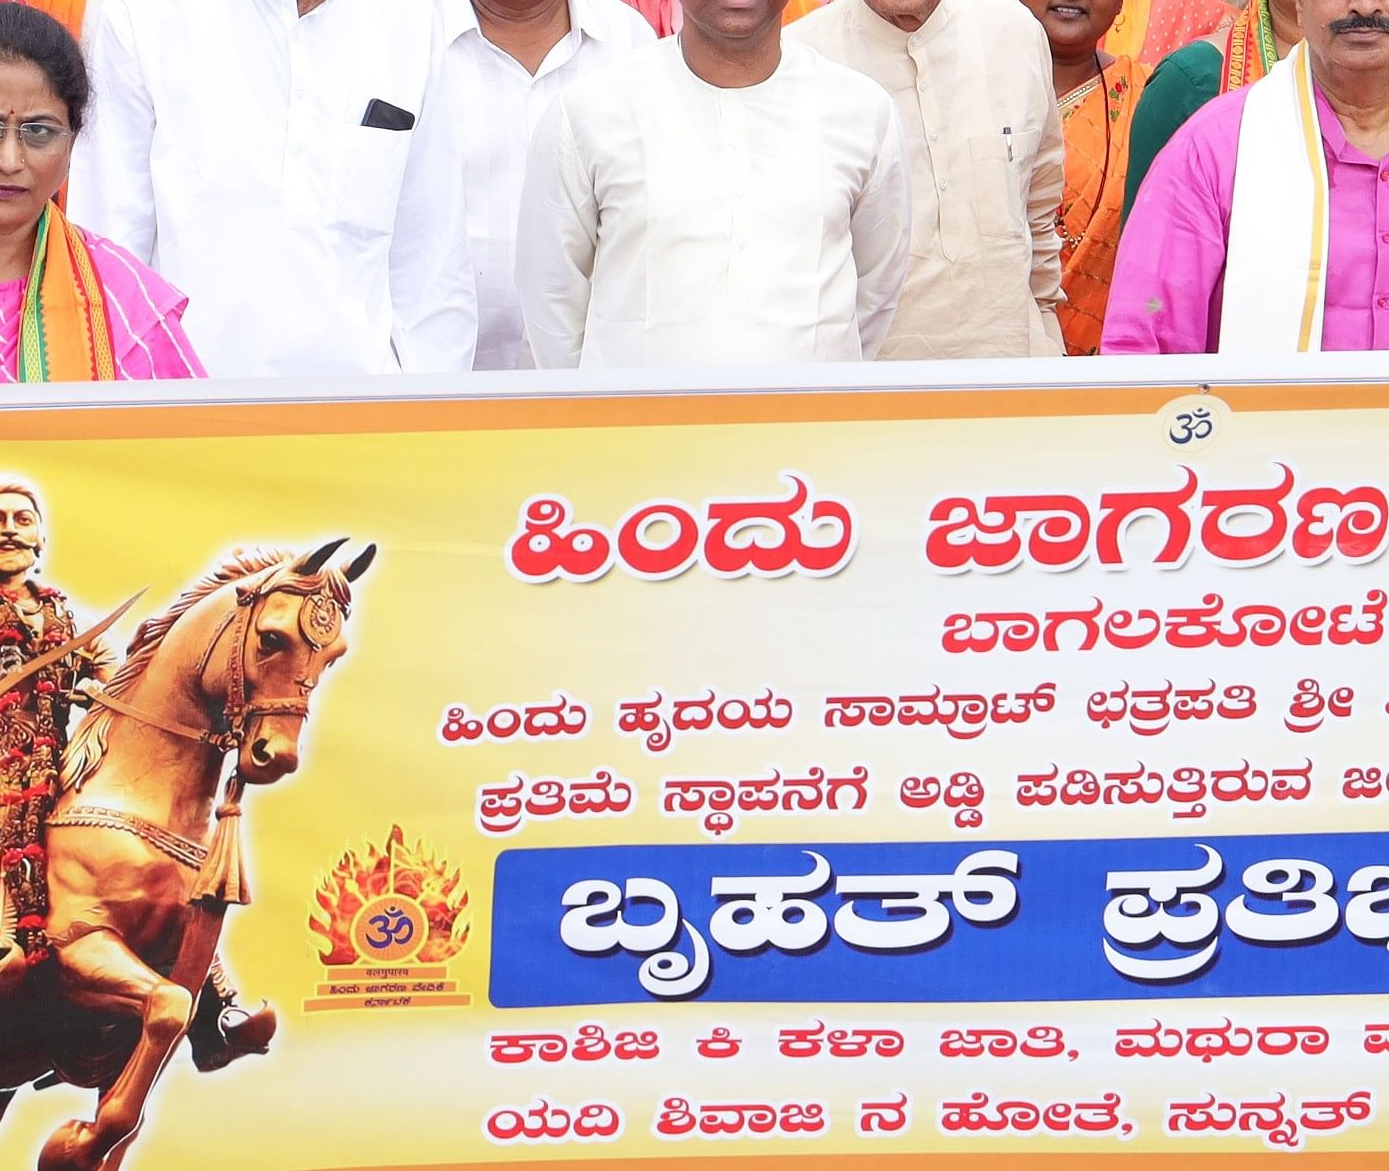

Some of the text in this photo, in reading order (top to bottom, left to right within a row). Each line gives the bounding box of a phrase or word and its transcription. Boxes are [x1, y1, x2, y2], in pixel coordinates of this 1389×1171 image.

[513, 474, 851, 575] ಹಿಂದು
[927, 463, 1388, 567] ಜಾಗರಣ
[943, 590, 1387, 654] ಬಾಗಲಕೋಟೆ
[443, 699, 584, 740] ಹಿಂದು
[620, 693, 791, 751] ಹೃದಯ
[826, 680, 1055, 739] ಸಾಮ್ರಾಟ್
[1088, 683, 1256, 735] ಛತ್ರಪತಿ
[1288, 678, 1353, 732] ಶ್ರೀ
[482, 769, 629, 831] ಪ್ರತಿಮೆ
[665, 764, 867, 833] ಸ್ಥಾಪನೆಗೆ
[901, 770, 984, 827] ಅಡ್ಡಿ
[1018, 763, 1311, 818] ಪಡಿಸುತ್ತಿರುವ
[560, 850, 1018, 996] ಬೃಹತ್
[492, 1024, 659, 1063] ಕಾಶಿಜಿ
[699, 1028, 739, 1057] ಕಿ
[780, 1023, 903, 1057] ಕಳಾ
[940, 1025, 1078, 1062] ಜಾತಿ,
[1116, 1021, 1328, 1062] ಮಥುರಾ
[488, 1102, 618, 1138] ಯದಿ
[658, 1097, 824, 1134] ಶಿವಾಜಿ
[862, 1097, 906, 1131] ನ
[943, 1091, 1132, 1137] ಹೋತೆ,
[1169, 1090, 1370, 1146] ಸುನ್ನತ್
